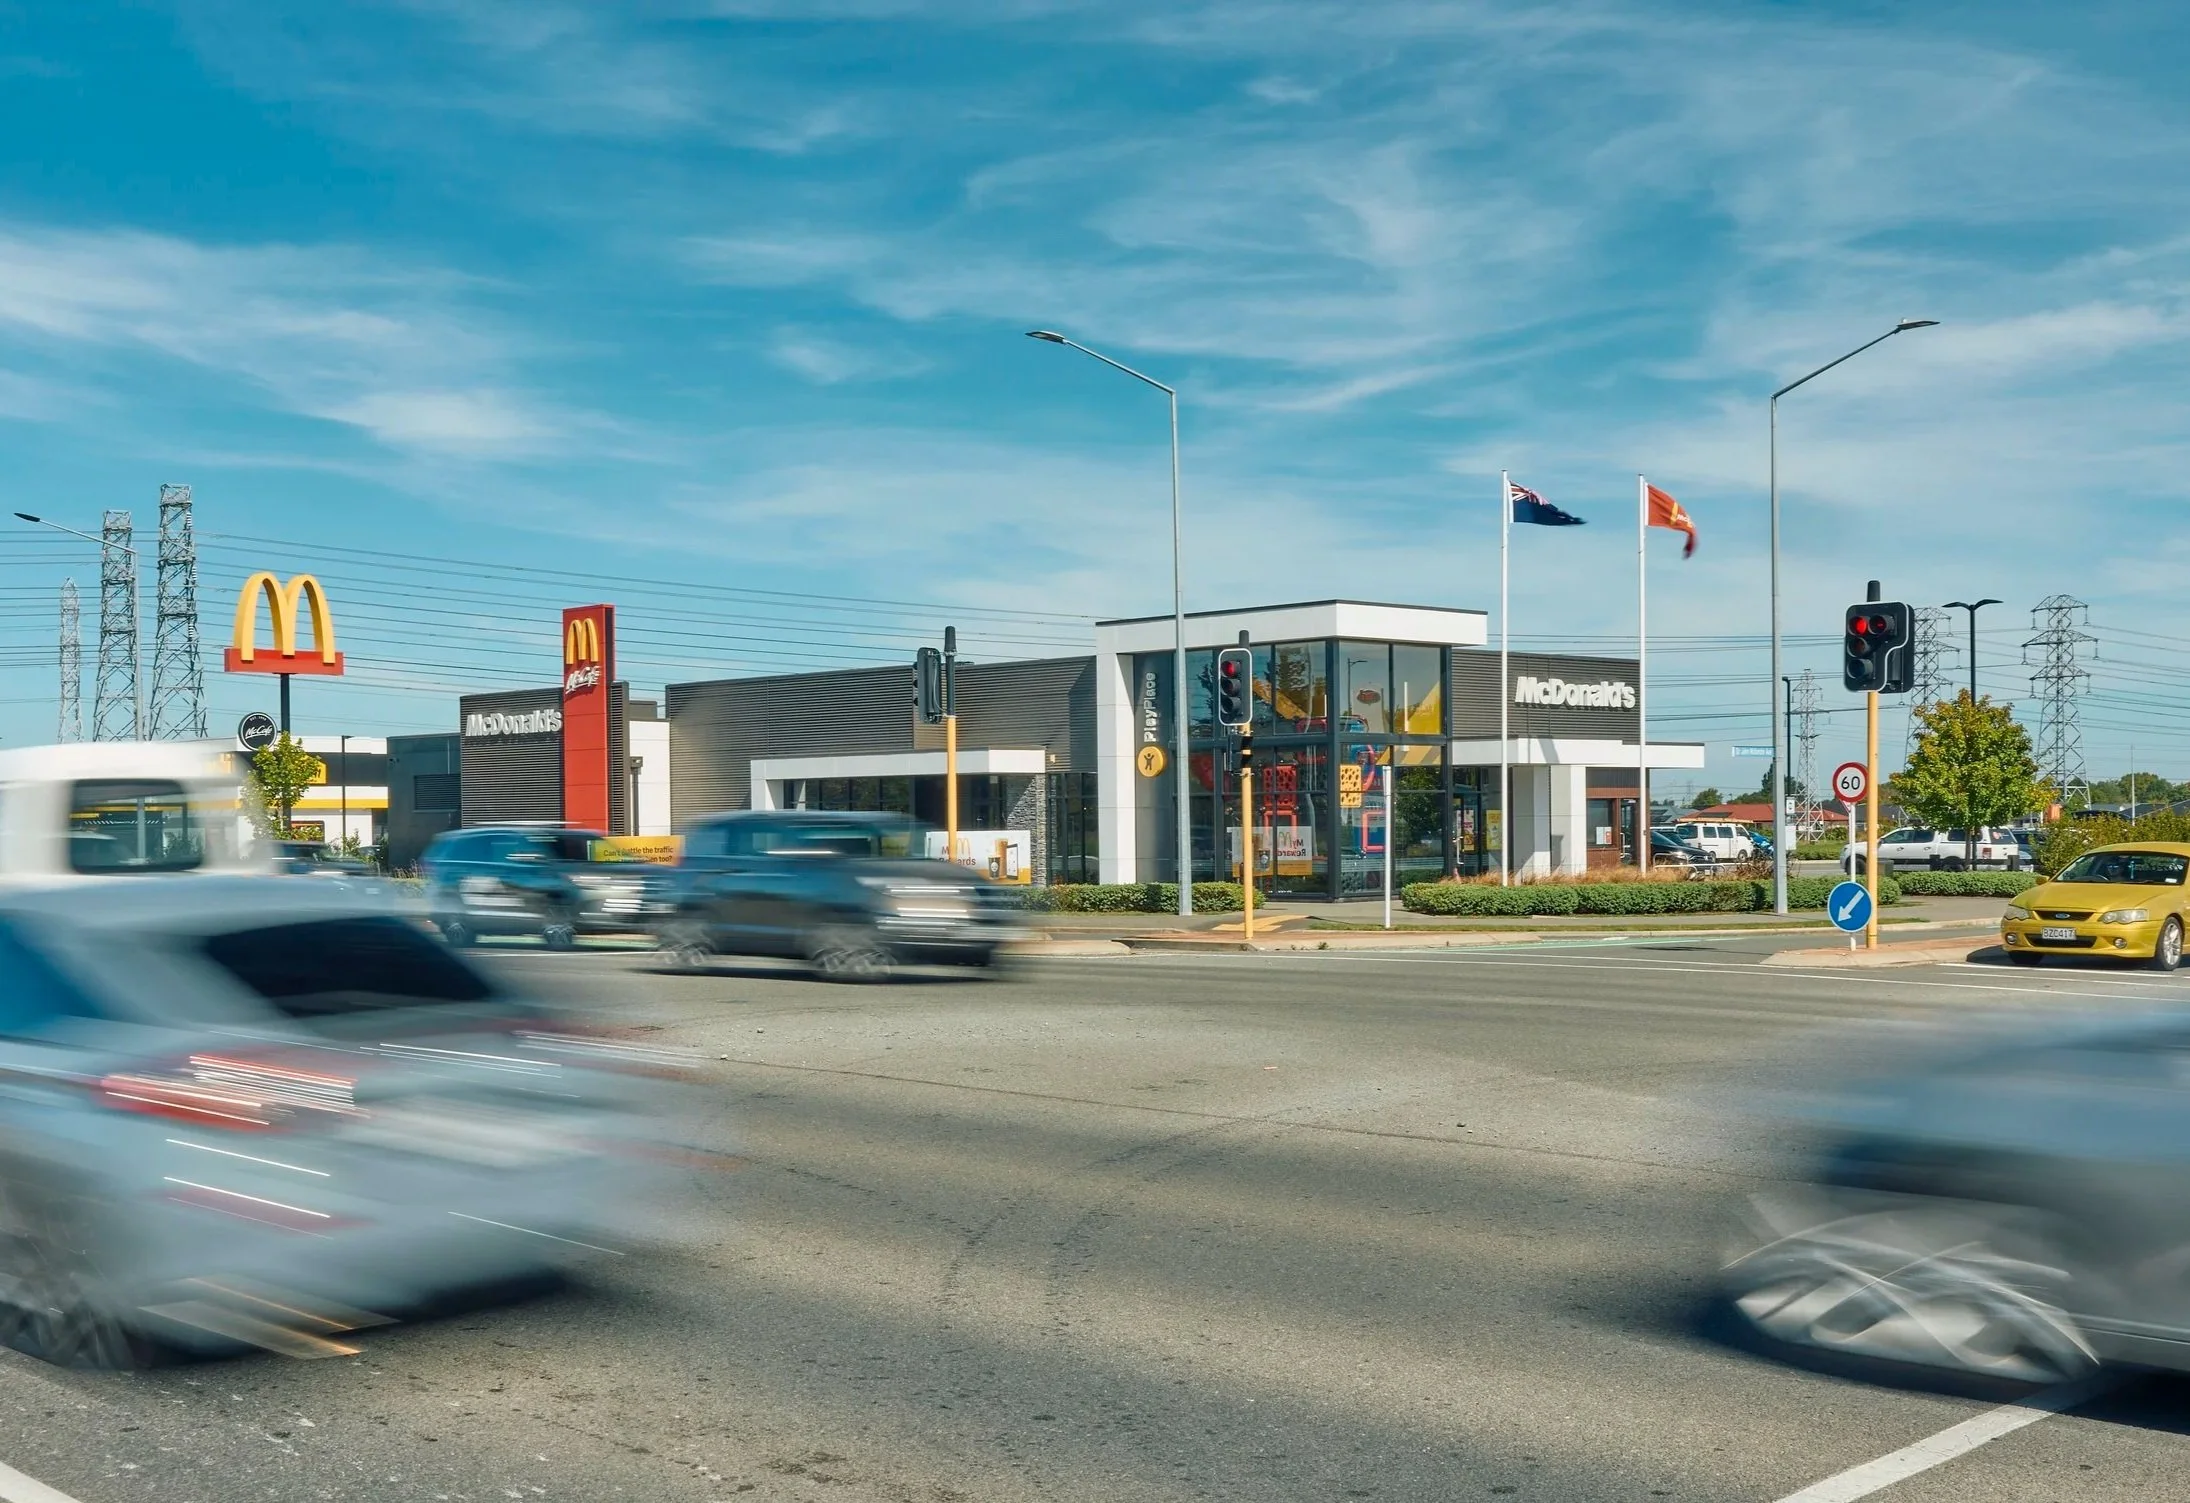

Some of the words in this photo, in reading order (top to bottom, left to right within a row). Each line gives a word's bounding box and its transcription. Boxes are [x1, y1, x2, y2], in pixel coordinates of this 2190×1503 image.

[1514, 676, 1636, 708] McDonald's
[1143, 672, 1157, 742] PlayPlace
[465, 708, 562, 737] McDonald's
[1841, 775, 1861, 790] 60
[642, 846, 654, 854] the
[654, 845, 674, 854] traffic
